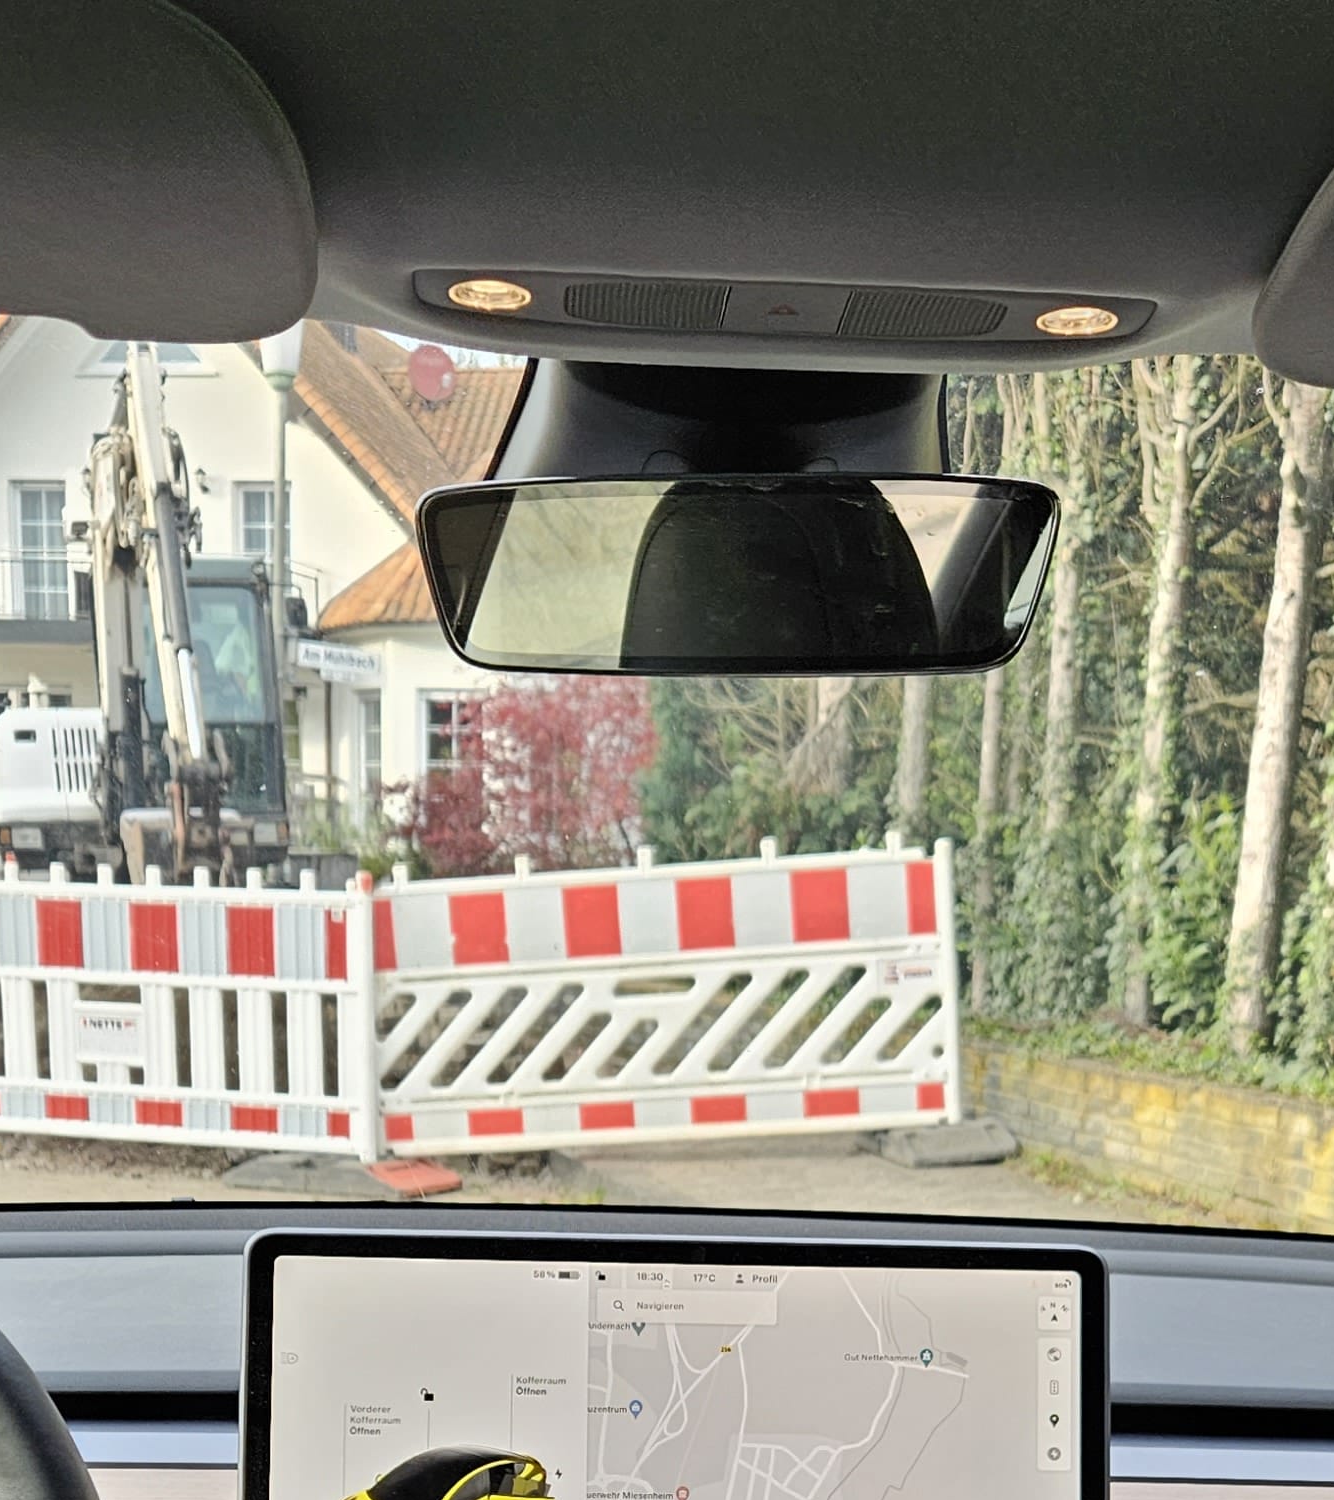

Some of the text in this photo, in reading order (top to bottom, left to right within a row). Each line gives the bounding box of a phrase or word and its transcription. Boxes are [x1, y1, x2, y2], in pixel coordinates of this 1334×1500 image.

[301, 647, 321, 661] Am
[637, 1272, 664, 1282] 18:30
[693, 1273, 716, 1283] 17°C
[752, 1274, 778, 1284] Profil
[636, 1302, 684, 1312] Navigieren
[844, 1353, 860, 1362] Gut
[516, 1376, 567, 1386] Kofferraum
[516, 1386, 547, 1396] Öffnen
[350, 1405, 391, 1414] Vorderer
[350, 1415, 401, 1425] Kofferraum
[349, 1426, 381, 1436] Öffnen
[622, 1491, 674, 1500] Miesenheim
